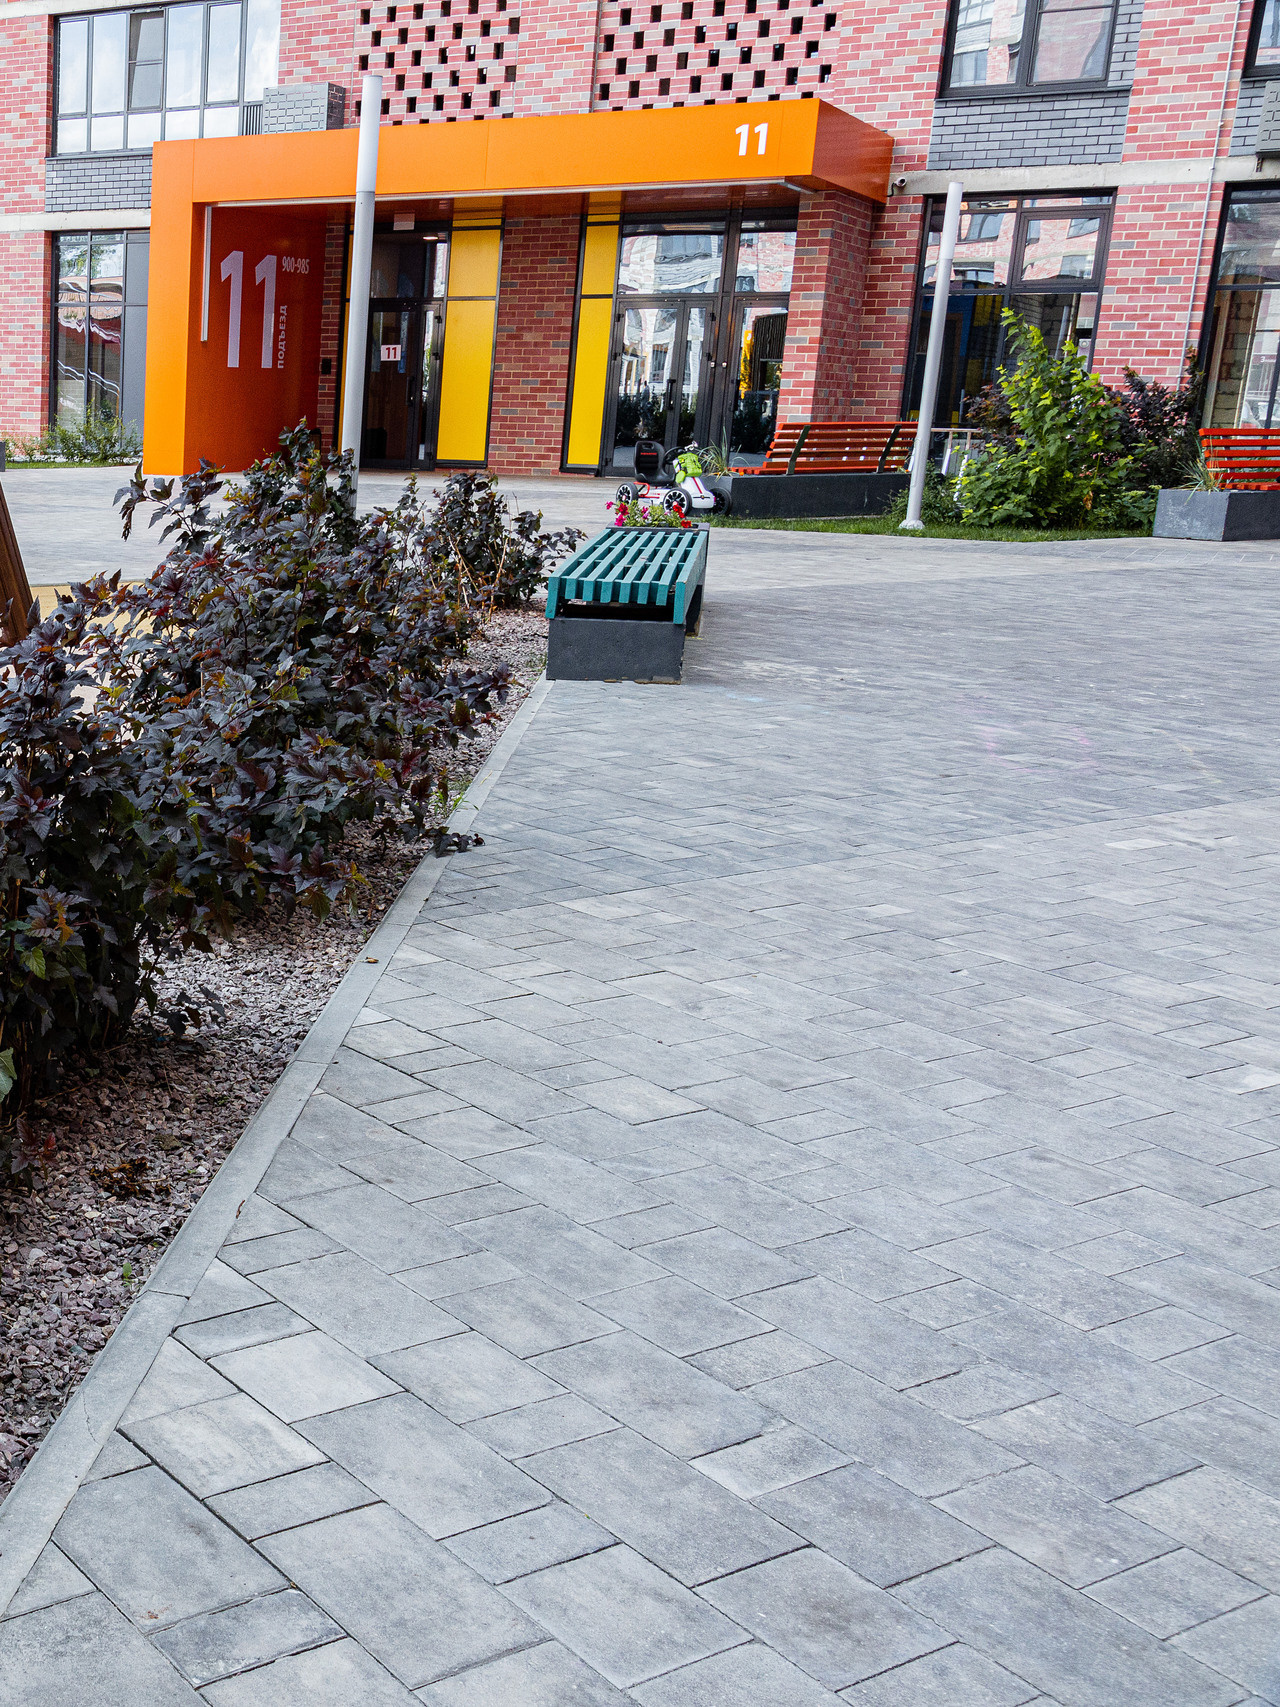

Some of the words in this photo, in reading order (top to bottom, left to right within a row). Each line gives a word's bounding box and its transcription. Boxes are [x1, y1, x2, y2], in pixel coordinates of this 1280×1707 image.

[735, 122, 769, 156] 11
[282, 256, 310, 274] 900-985
[220, 250, 277, 368] 11
[277, 304, 288, 368] ПОДЪЕЗД
[385, 346, 397, 359] 11
